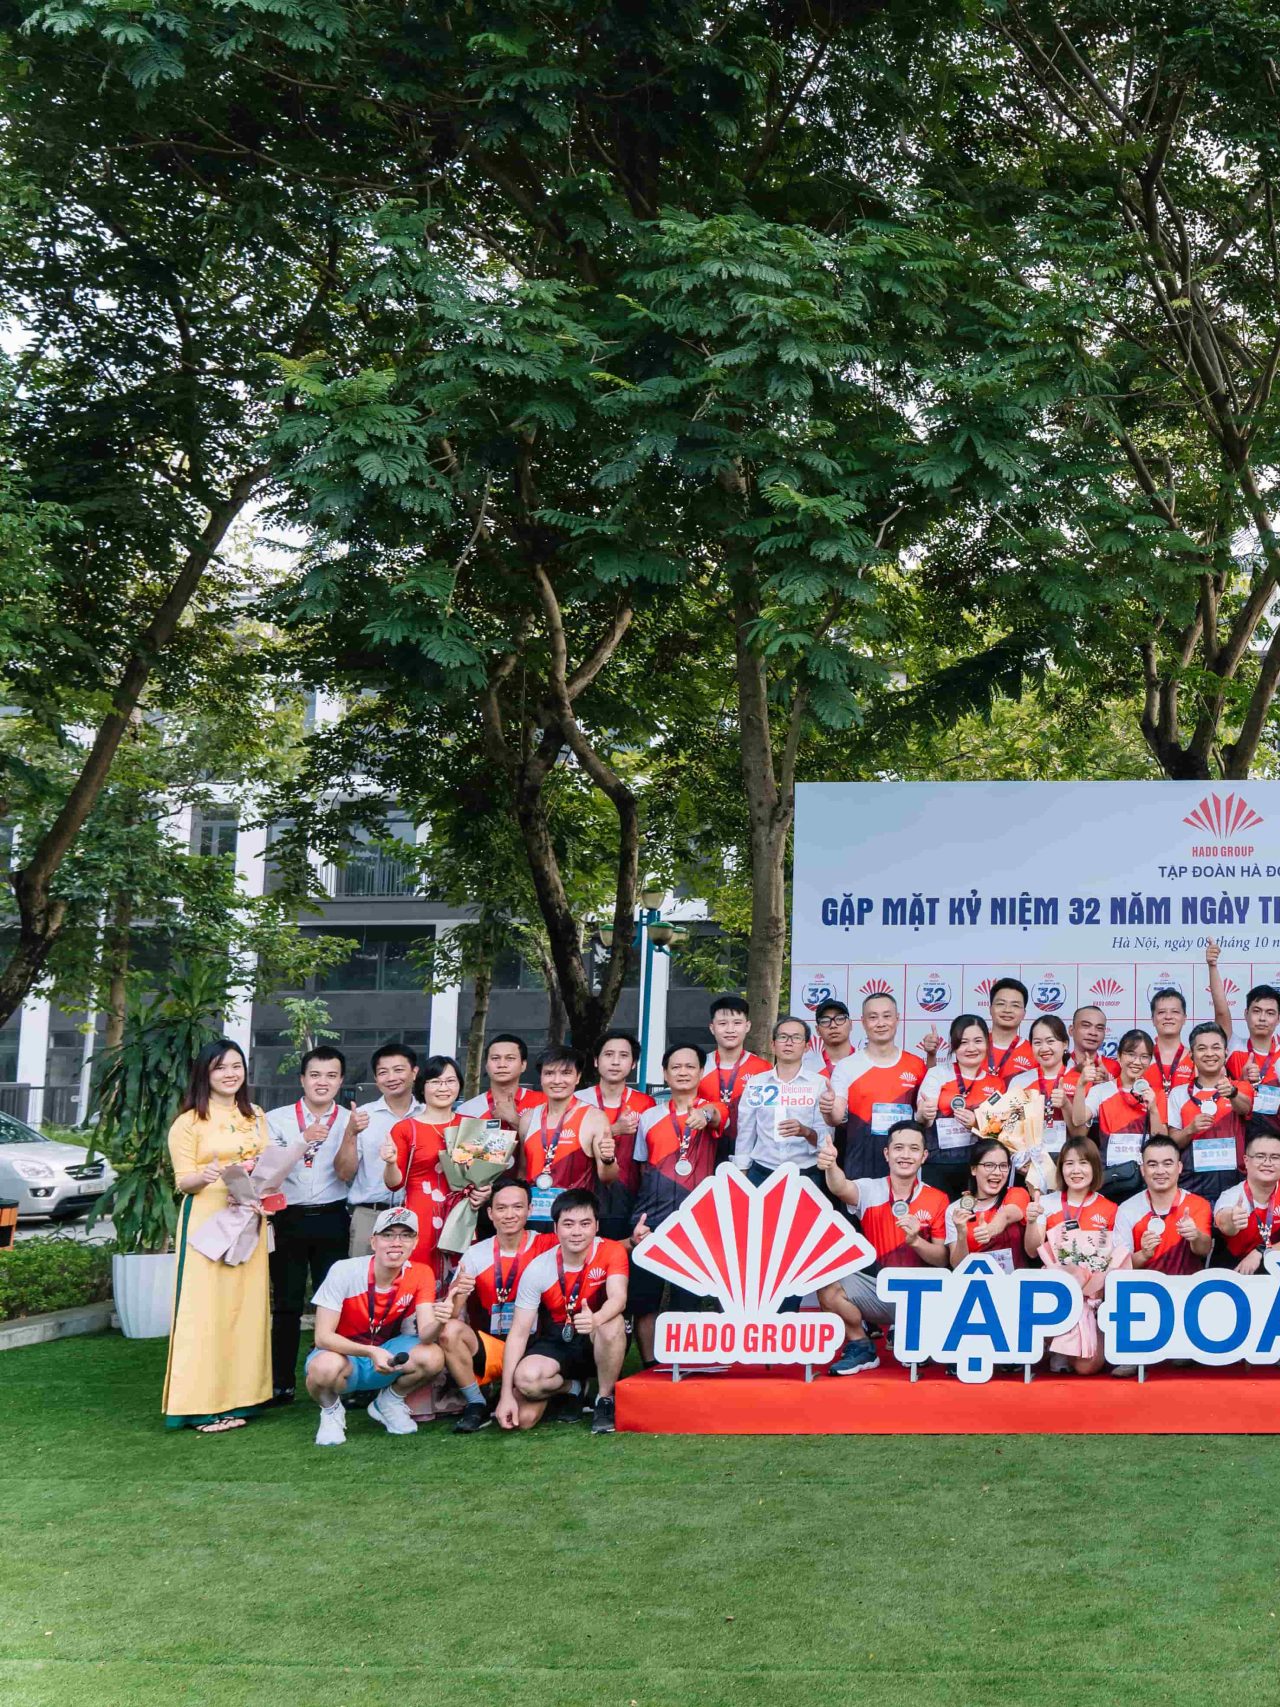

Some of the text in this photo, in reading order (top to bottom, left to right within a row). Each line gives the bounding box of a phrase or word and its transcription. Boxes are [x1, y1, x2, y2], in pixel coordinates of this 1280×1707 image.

[1191, 846, 1255, 857] HADO GROUP
[1158, 864, 1188, 881] TẬP
[1192, 862, 1236, 878] ĐOÀN
[1240, 862, 1262, 877] HÀ
[821, 892, 873, 932] GẶP
[882, 892, 940, 932] MẶT
[949, 889, 981, 926] KỶ
[990, 891, 1058, 932] NIỆM
[1068, 897, 1101, 926] 32
[1110, 891, 1171, 925] NĂM
[1181, 890, 1250, 925] NGÀY
[1111, 936, 1131, 948] Hà
[1134, 936, 1160, 951] Nội,
[1164, 936, 1194, 952] ngày
[1216, 936, 1251, 951] tháng
[1254, 936, 1269, 948] 10
[807, 987, 831, 1004] 32
[922, 987, 946, 1004] 32
[1037, 987, 1061, 1004] 32
[747, 1085, 780, 1106] 32
[781, 1095, 815, 1106] Hado
[888, 1260, 1073, 1372] TẬP
[665, 1323, 835, 1353] HADO GROUP
